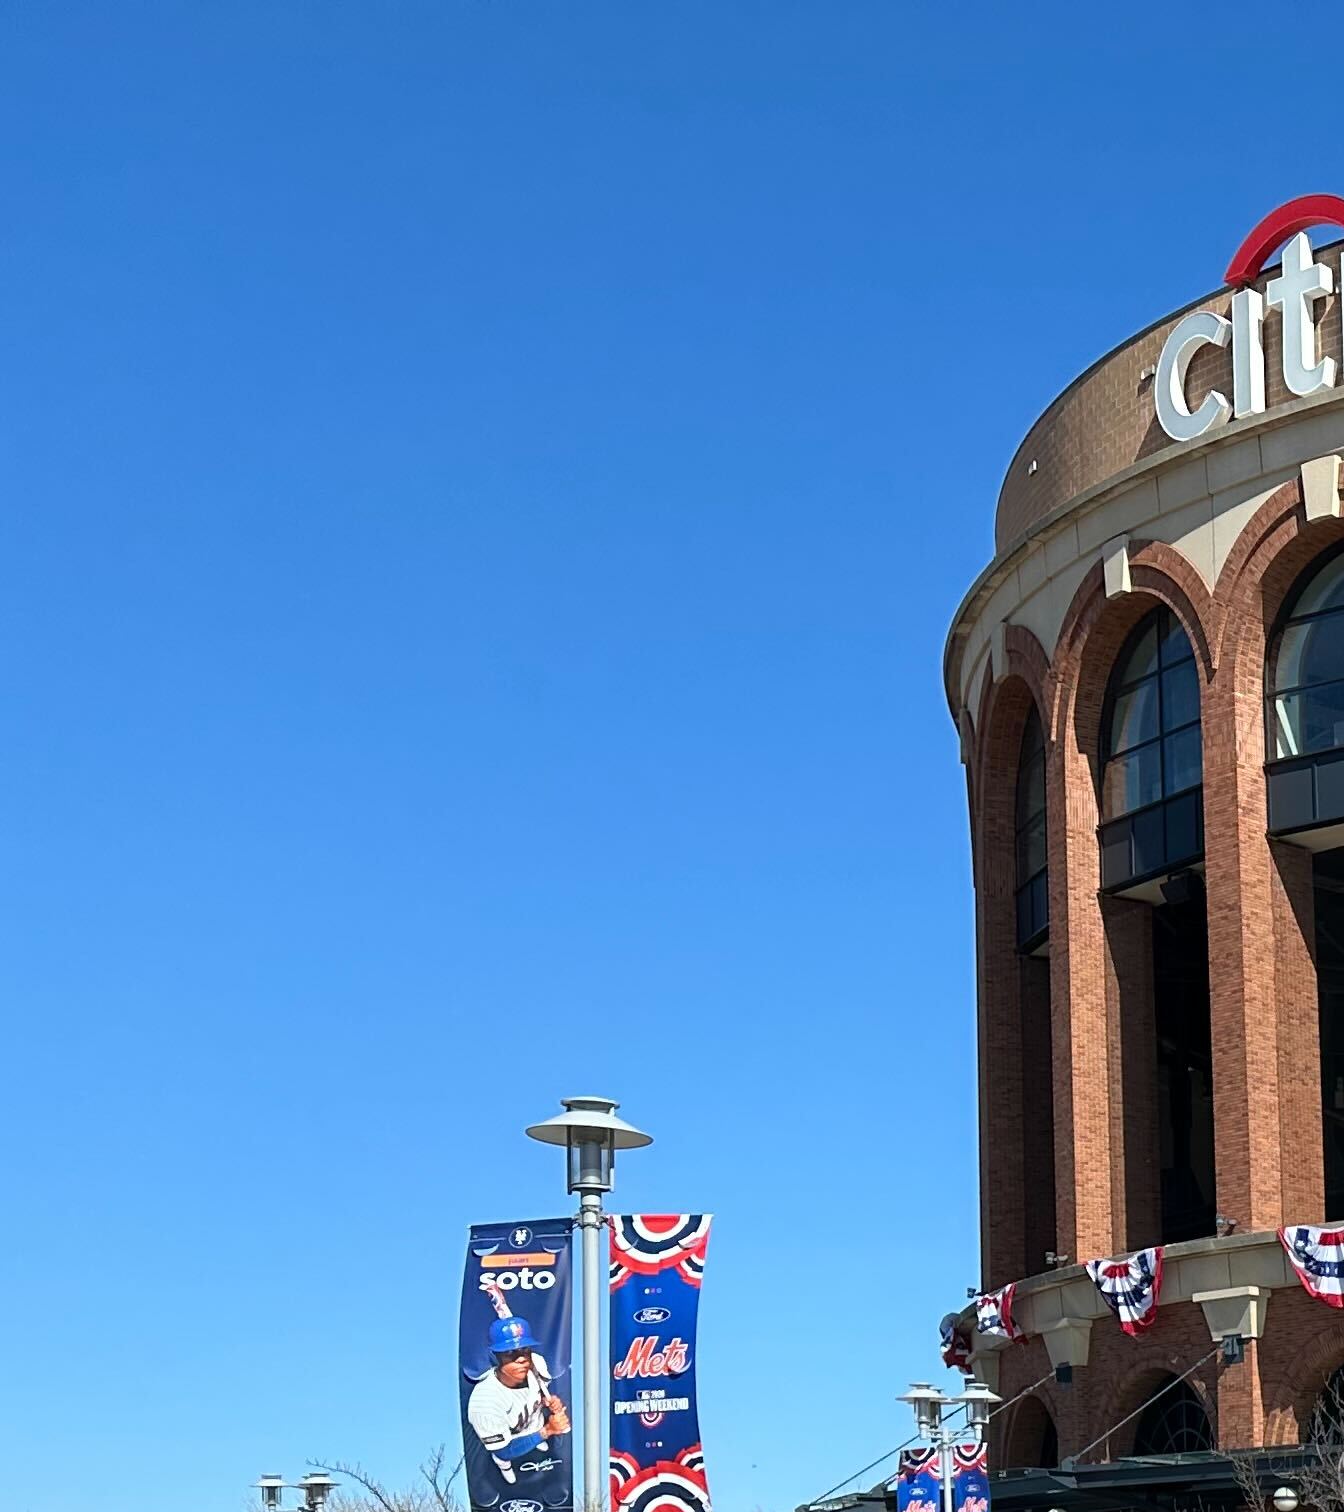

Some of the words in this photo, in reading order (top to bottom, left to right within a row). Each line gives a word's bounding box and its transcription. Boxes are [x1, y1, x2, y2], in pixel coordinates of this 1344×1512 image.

[479, 1267, 556, 1291] soto
[640, 1308, 664, 1321] Ford
[613, 1336, 689, 1380] Mets
[614, 1401, 650, 1415] OPENING
[649, 1397, 689, 1412] WEEKEND
